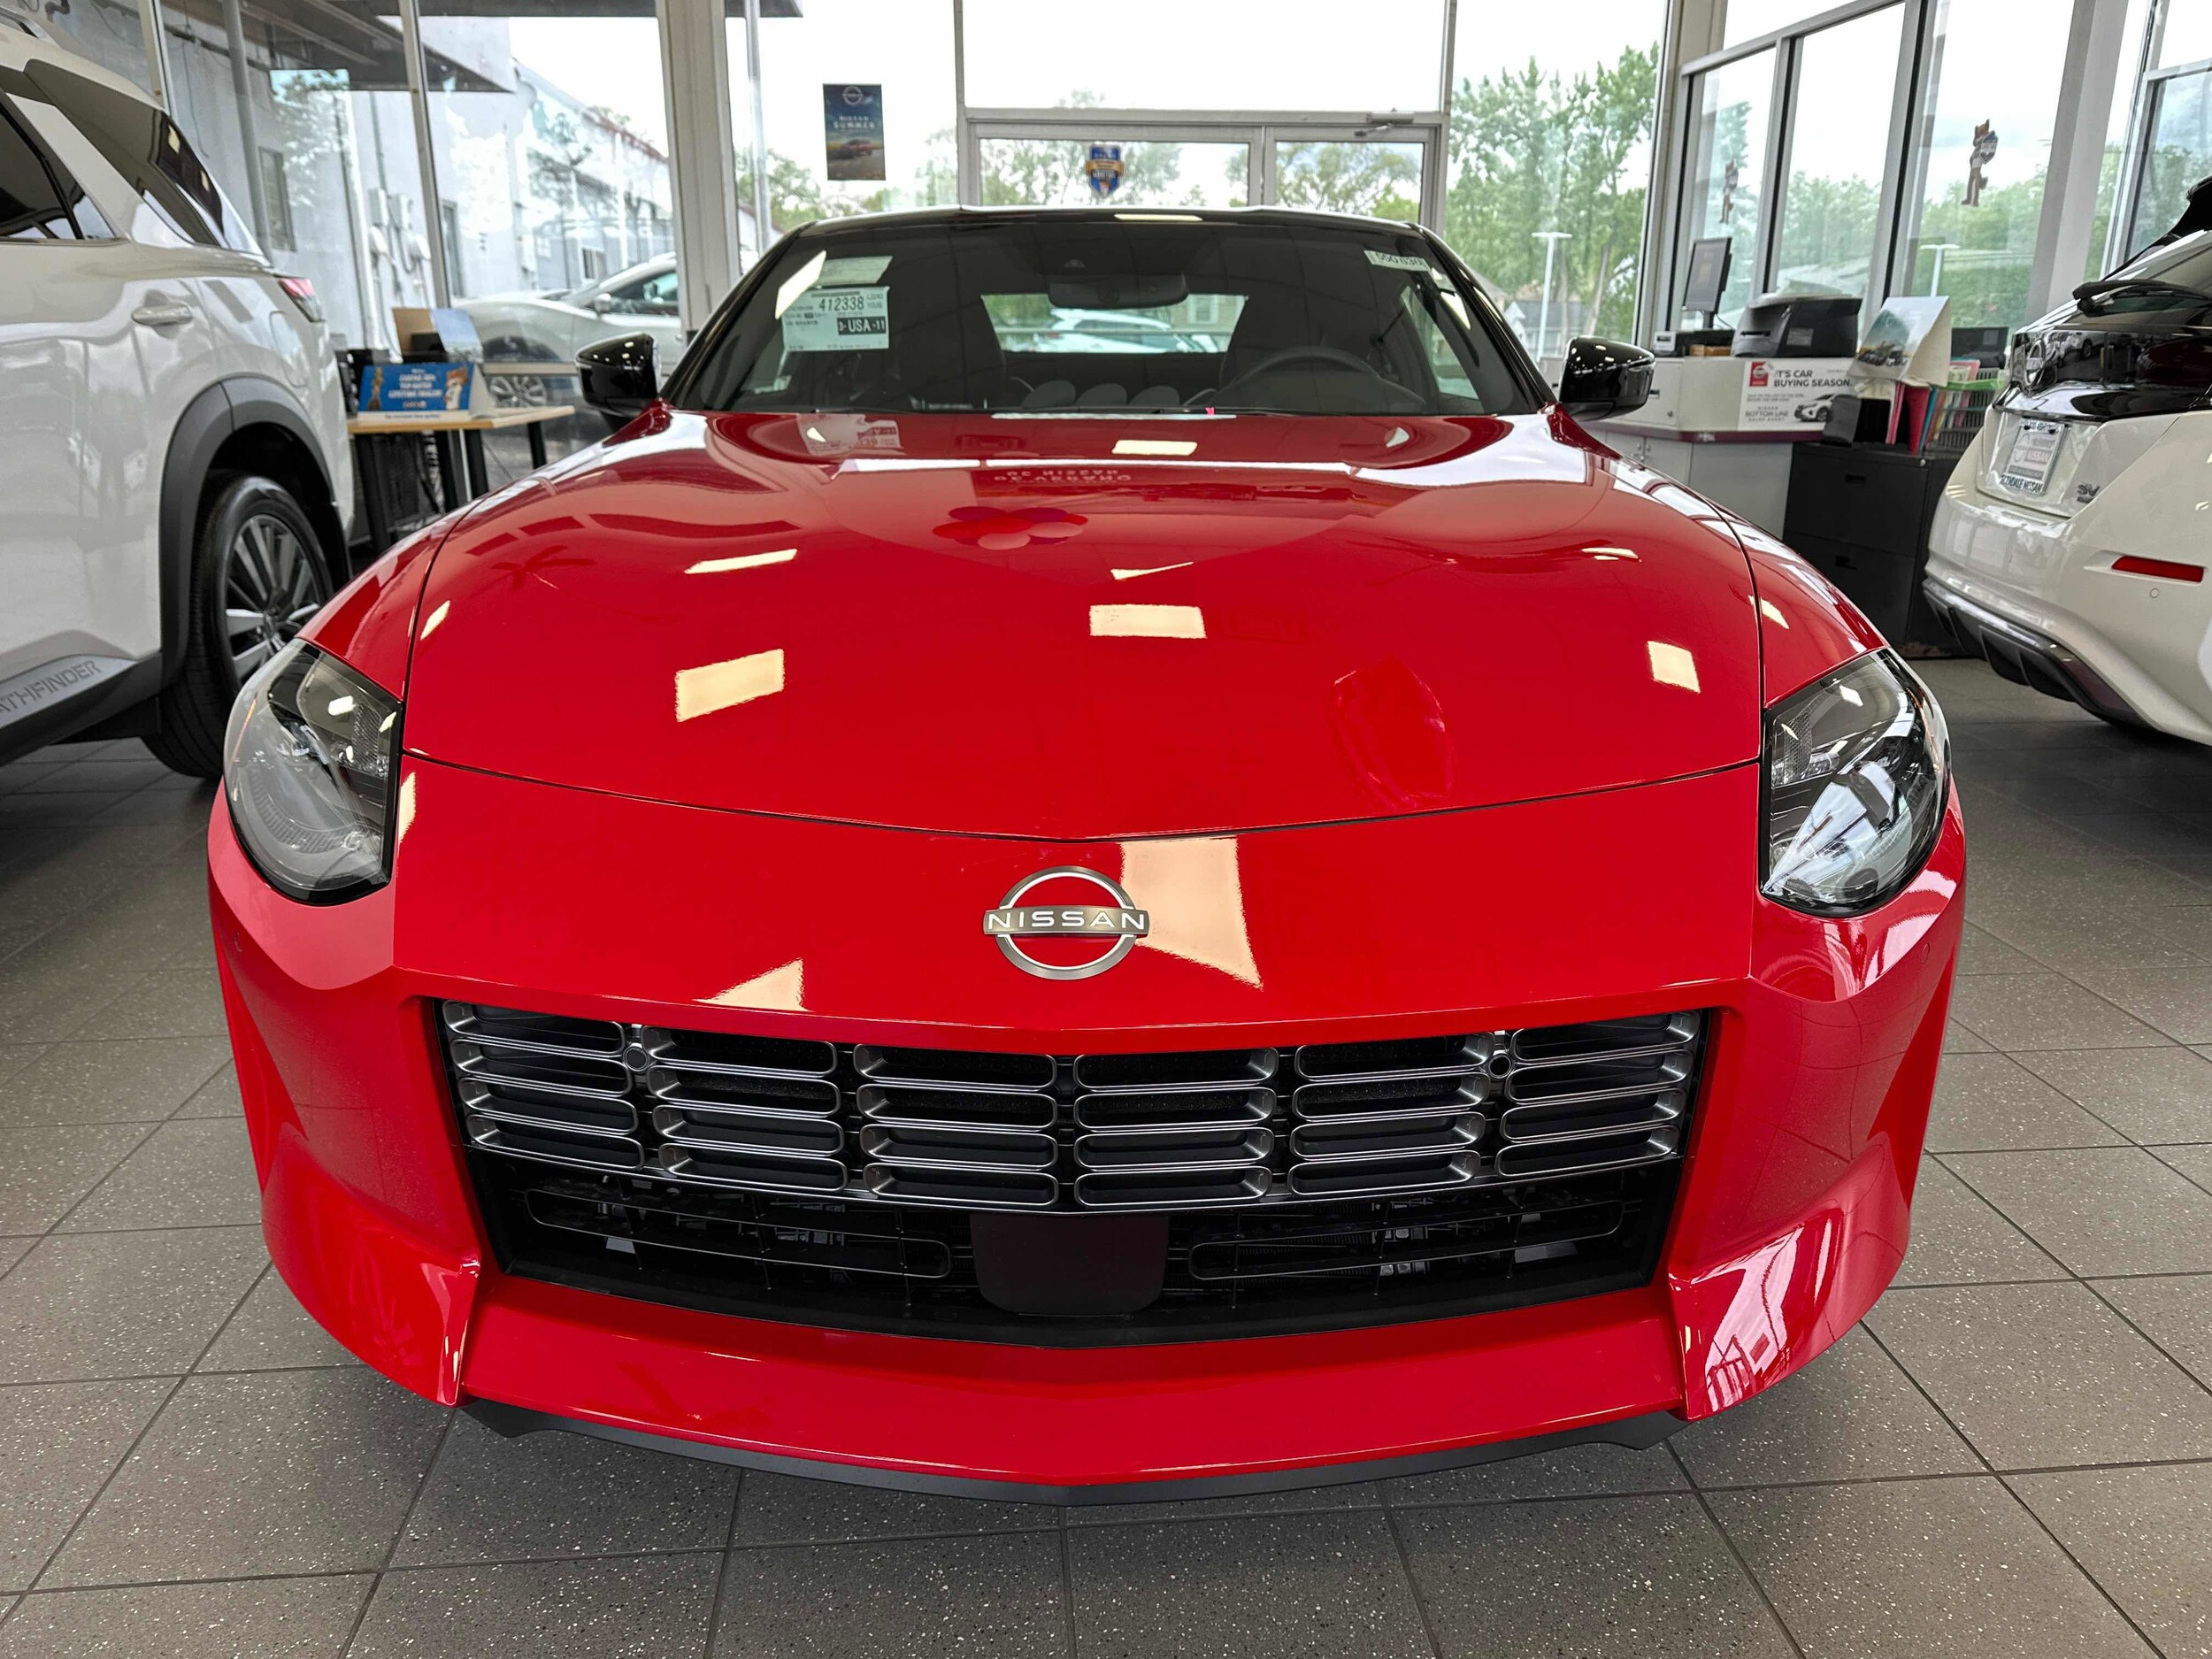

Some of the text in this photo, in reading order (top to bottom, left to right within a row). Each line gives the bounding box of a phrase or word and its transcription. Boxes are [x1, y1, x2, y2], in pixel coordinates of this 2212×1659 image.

[819, 296, 864, 311] 412338
[848, 319, 872, 332] USA
[1773, 379, 1809, 388] BUYING
[2077, 483, 2101, 496] SV
[987, 910, 1144, 930] NISSAN
